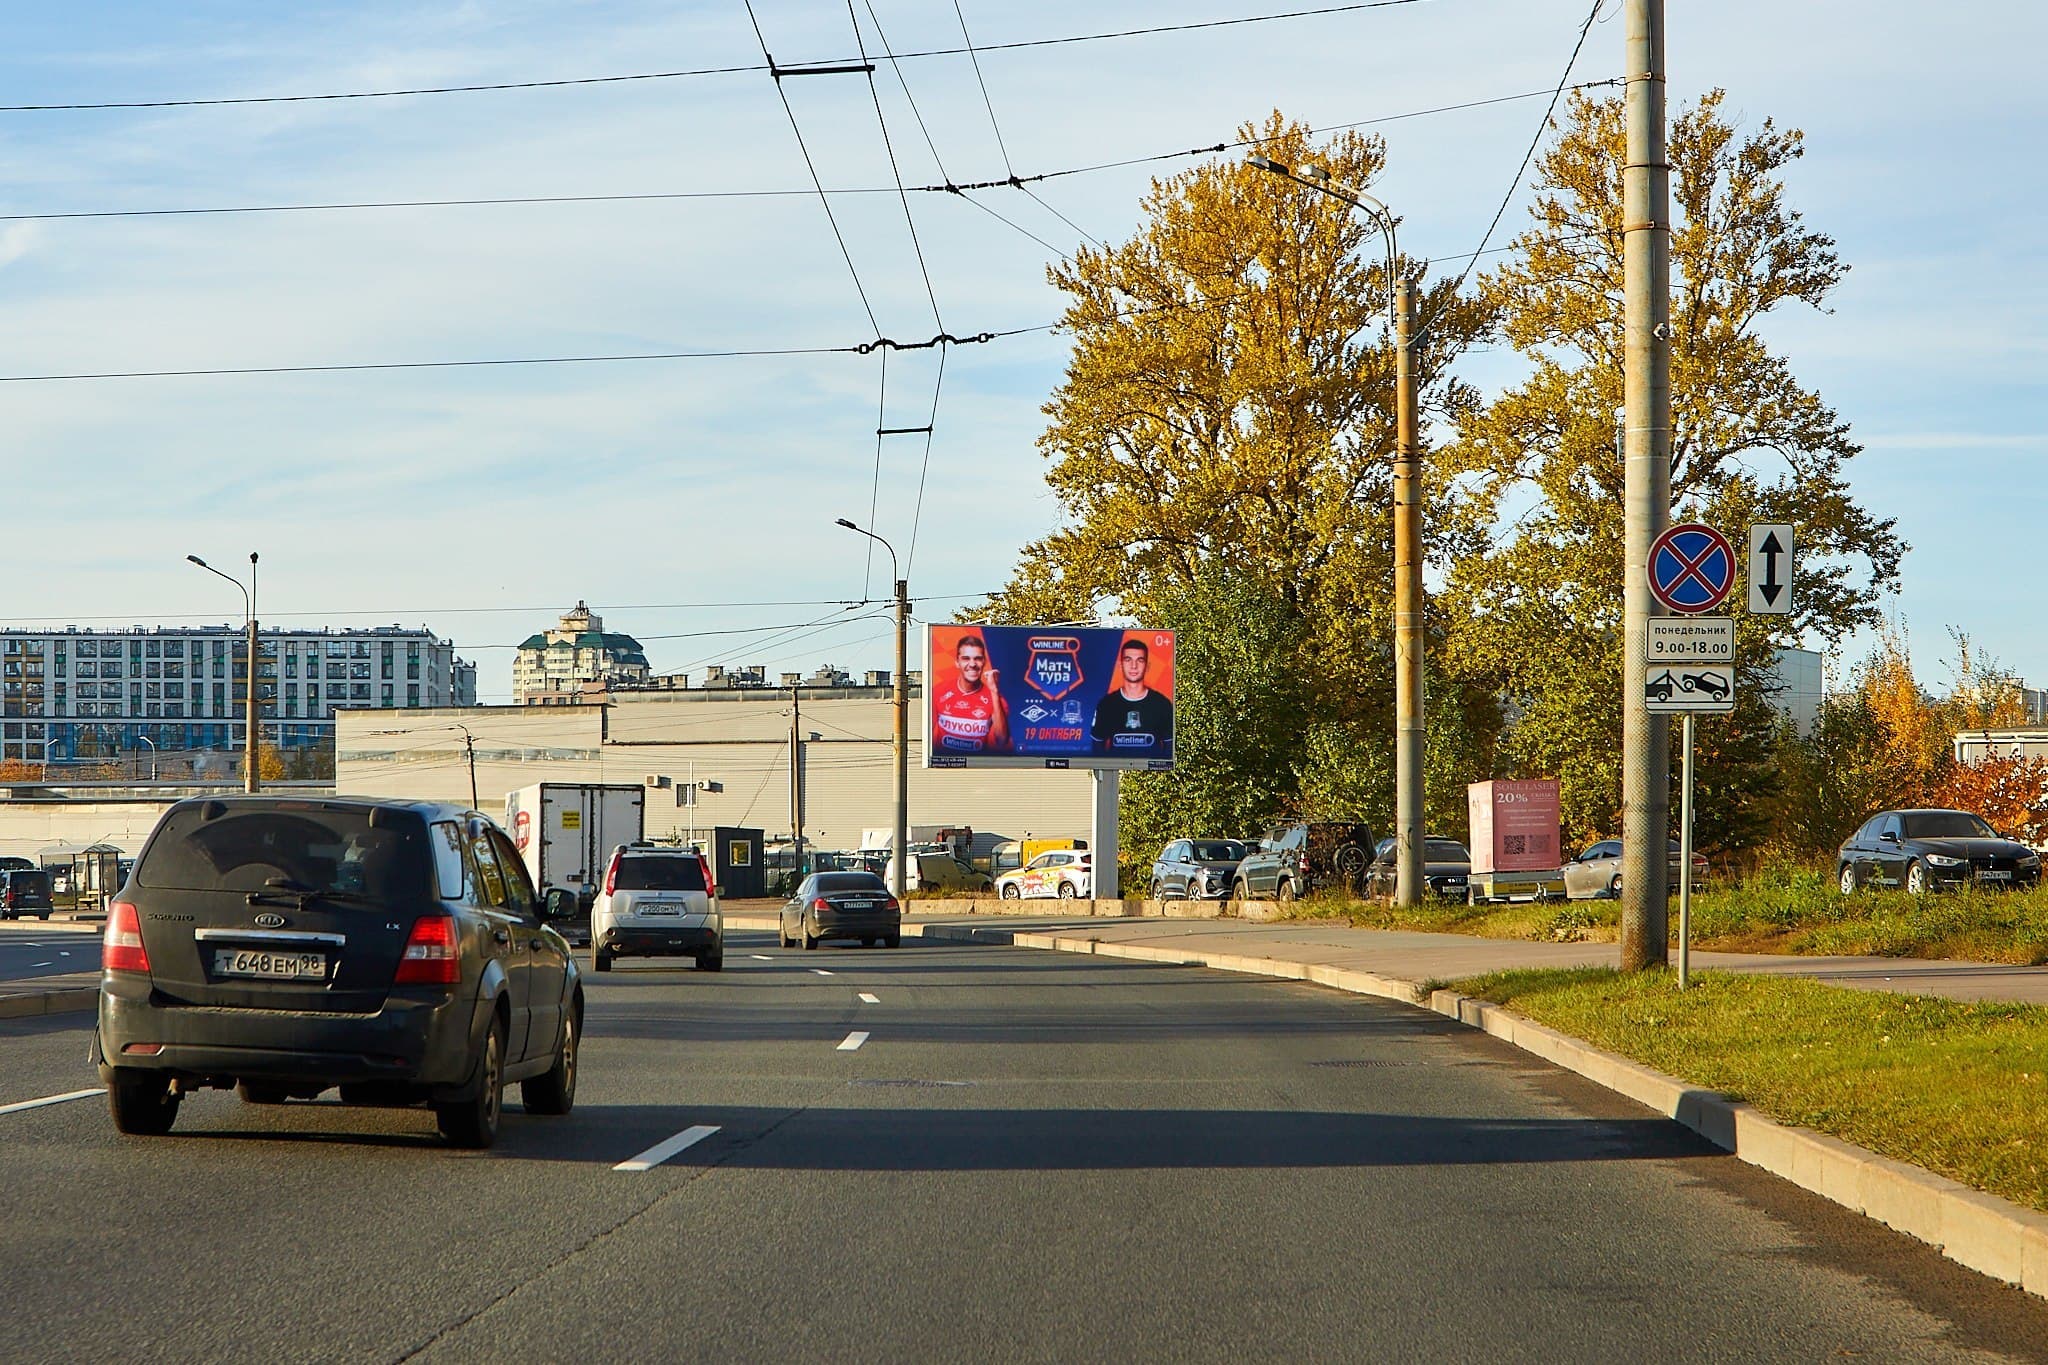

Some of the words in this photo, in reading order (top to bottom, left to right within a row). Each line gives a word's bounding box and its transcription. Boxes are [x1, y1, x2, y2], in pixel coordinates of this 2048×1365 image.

[1654, 627, 1726, 635] понедельник
[1033, 641, 1065, 649] WINLINE
[1155, 635, 1171, 647] 0+
[1655, 641, 1728, 654] 9.00-18.00
[1036, 658, 1071, 672] Матч
[1038, 672, 1070, 685] тура
[943, 719, 986, 734] ЛУКОЙЛ
[1025, 728, 1036, 740] 19
[1038, 728, 1083, 740] ОКТЯБРЯ
[1497, 792, 1528, 803] 20%
[259, 915, 280, 926] KIA
